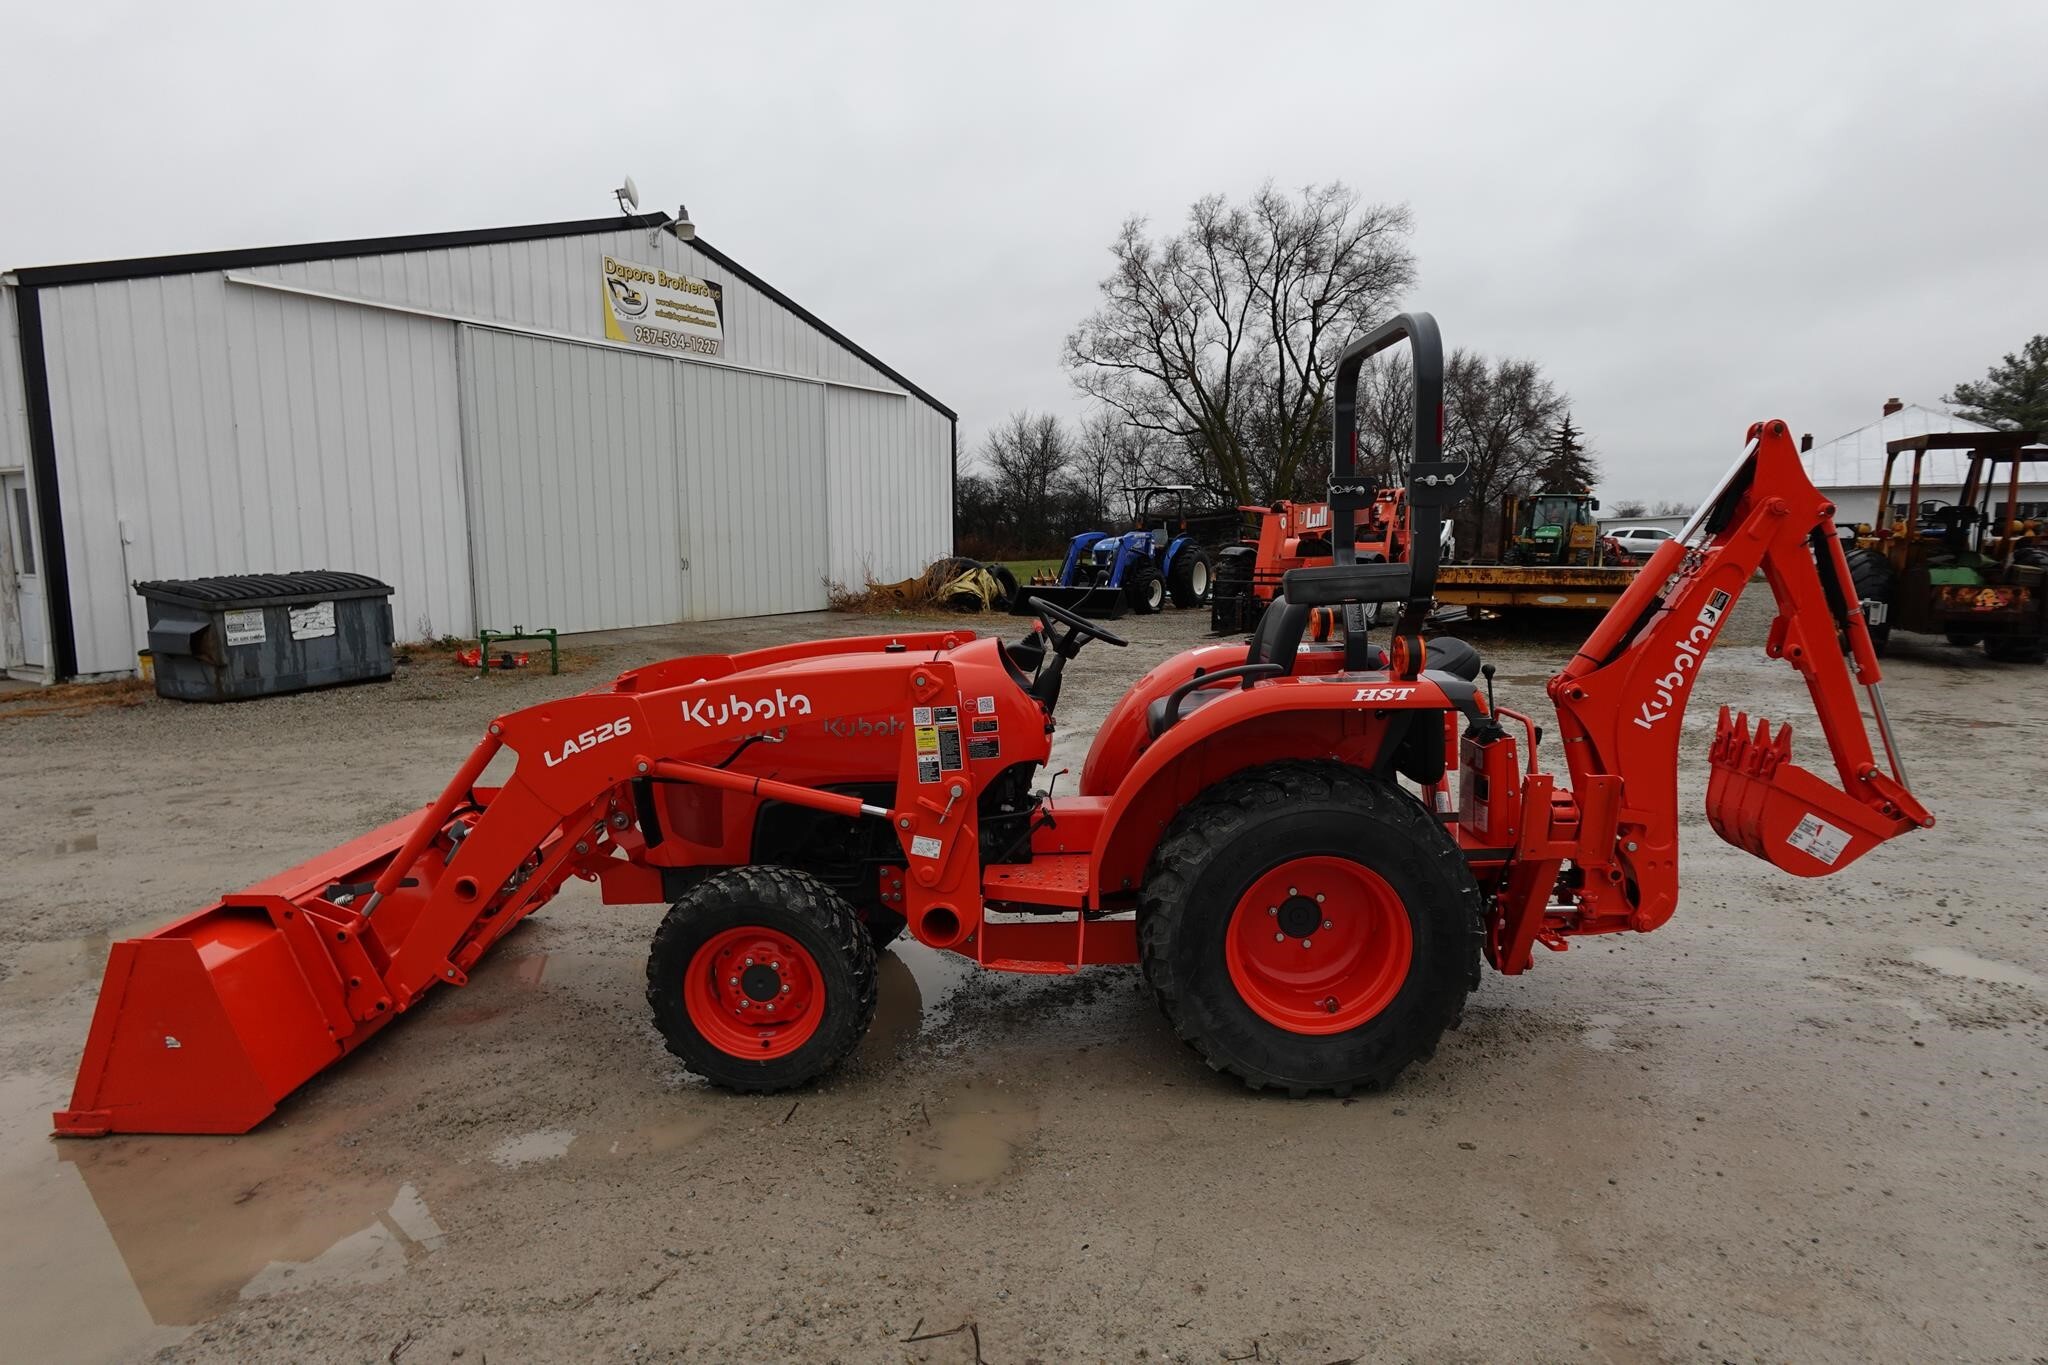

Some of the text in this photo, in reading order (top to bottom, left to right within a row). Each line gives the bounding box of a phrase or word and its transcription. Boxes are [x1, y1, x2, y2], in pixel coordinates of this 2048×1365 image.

[604, 256, 655, 285] Dapore
[658, 270, 709, 298] Brothers
[634, 325, 719, 355] 937-564-1227
[1305, 506, 1328, 528] Lull
[1351, 687, 1416, 702] HST
[1633, 625, 1713, 730] Kubota
[681, 688, 812, 728] Kubota
[543, 716, 632, 768] LA526
